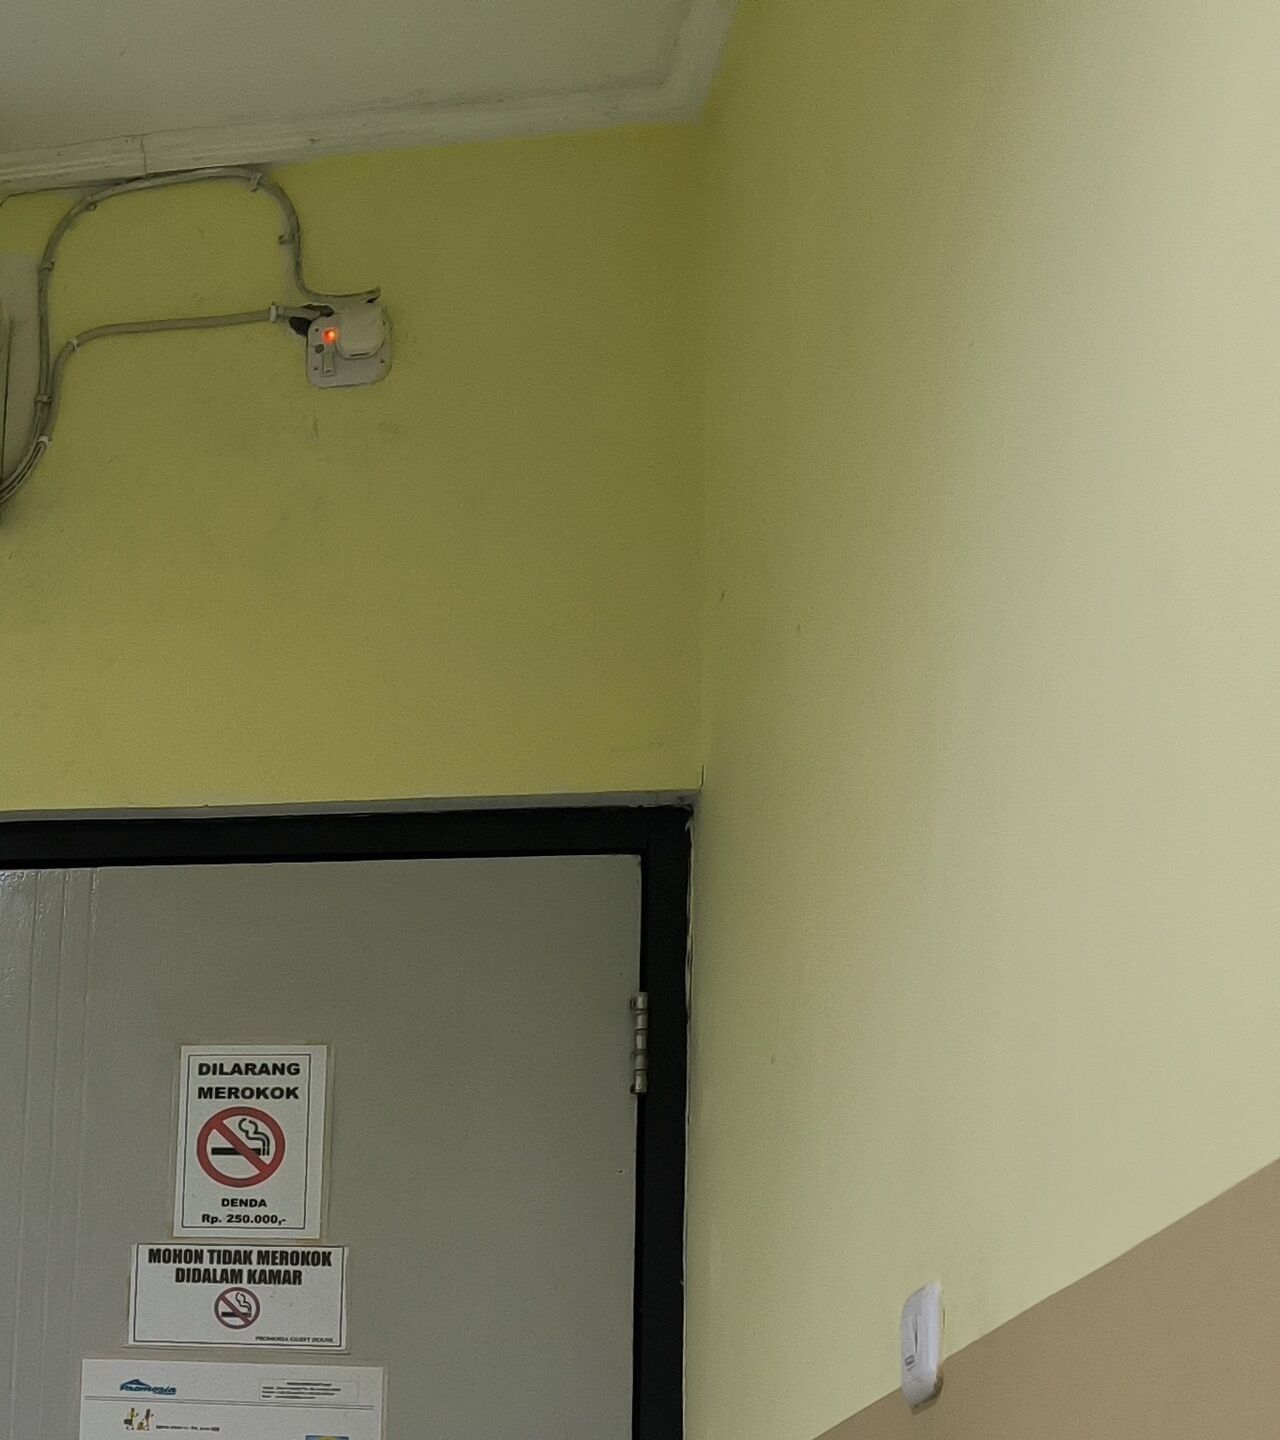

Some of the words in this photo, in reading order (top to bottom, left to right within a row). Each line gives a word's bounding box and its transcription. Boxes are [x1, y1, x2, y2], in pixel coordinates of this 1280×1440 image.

[198, 1063, 300, 1076] DILARANG
[198, 1087, 299, 1100] MEROKOK
[221, 1198, 267, 1208] DENDA
[201, 1214, 222, 1225] Rp.
[226, 1214, 287, 1226] 250.000,-
[148, 1248, 204, 1264] MOHON
[207, 1249, 253, 1265] TIDAK
[256, 1250, 333, 1267] MEROKOK
[175, 1267, 244, 1284] DIDALAM
[246, 1269, 303, 1285] KAMAR
